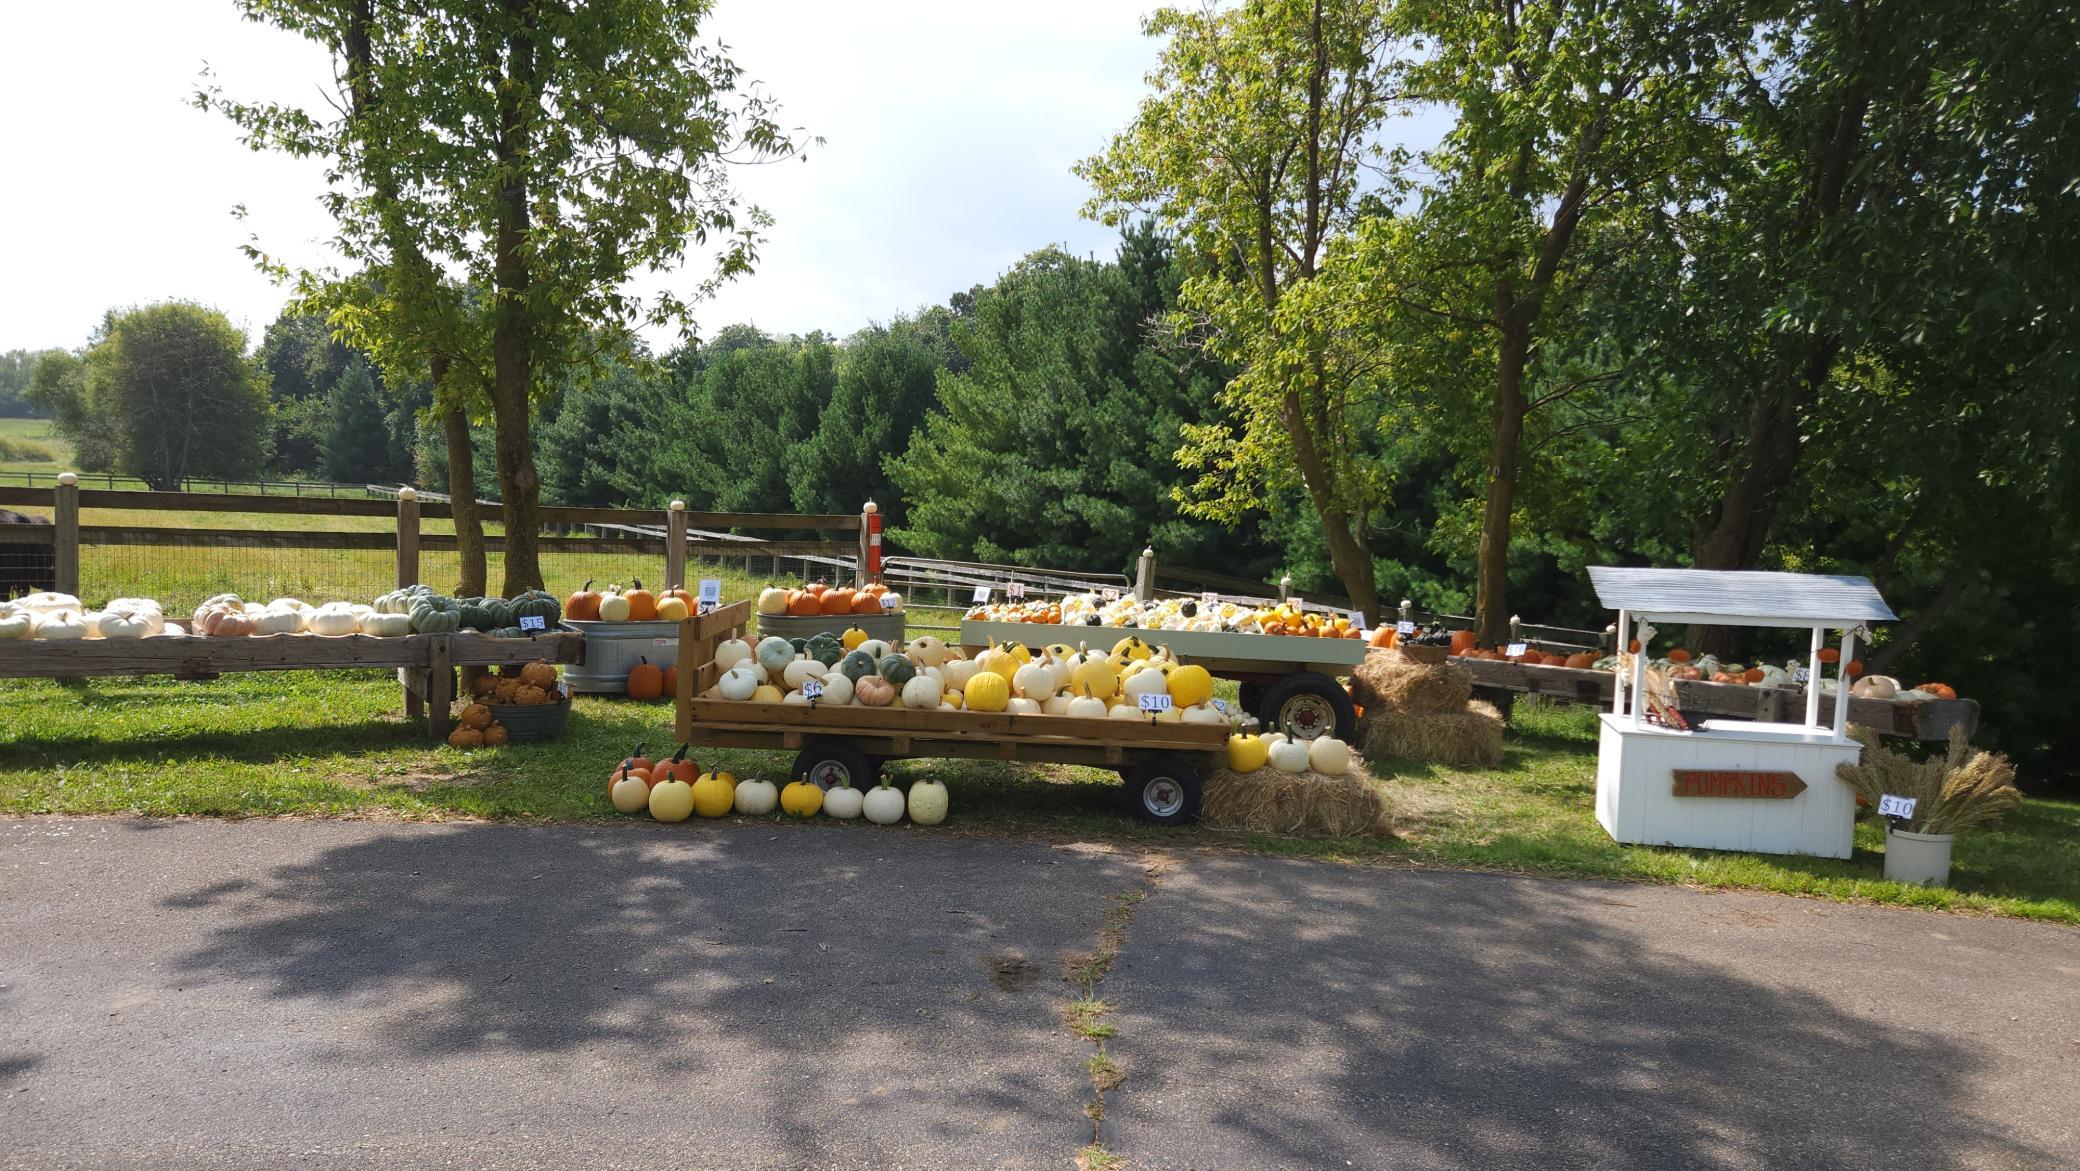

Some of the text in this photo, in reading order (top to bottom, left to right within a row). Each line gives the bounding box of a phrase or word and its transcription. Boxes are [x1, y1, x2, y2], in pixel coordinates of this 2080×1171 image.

[521, 617, 544, 629] $15
[804, 680, 822, 697] $6
[1140, 693, 1170, 709] $10
[1682, 772, 1787, 797] PUMPKINS
[1880, 798, 1913, 816] $10
